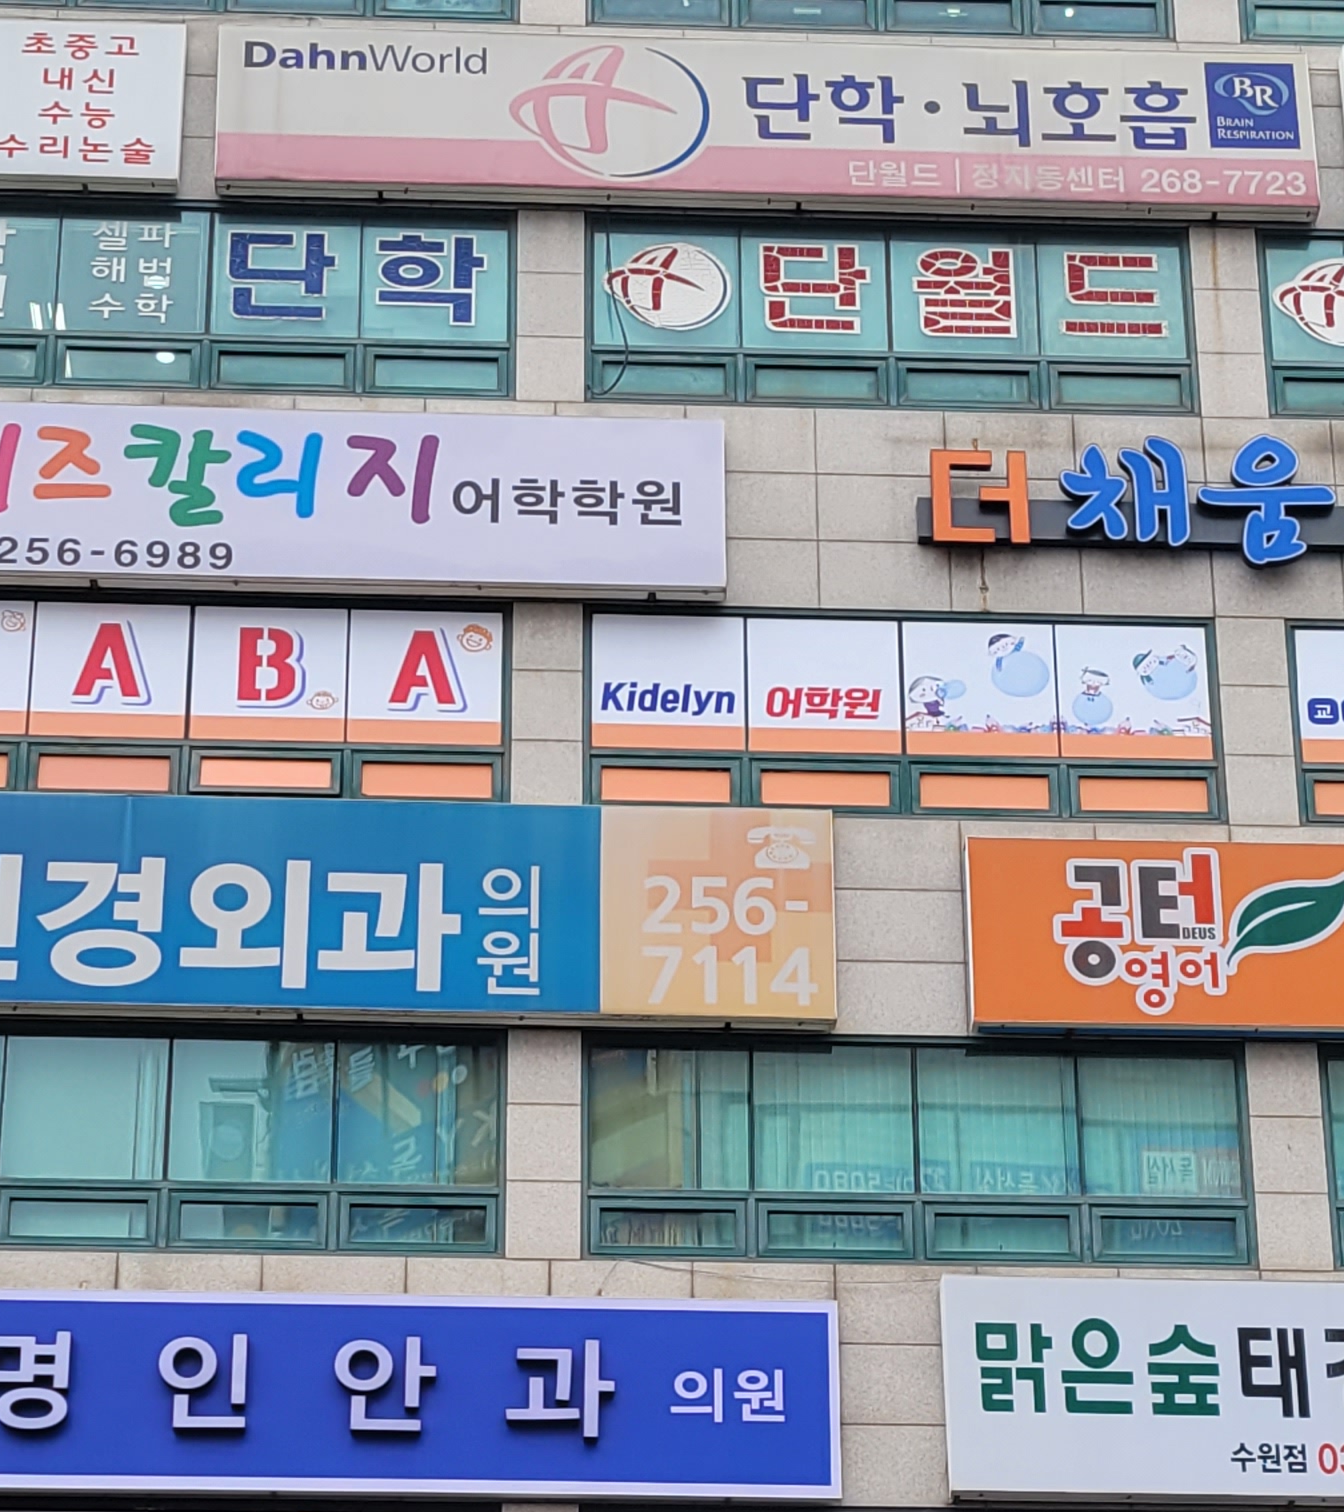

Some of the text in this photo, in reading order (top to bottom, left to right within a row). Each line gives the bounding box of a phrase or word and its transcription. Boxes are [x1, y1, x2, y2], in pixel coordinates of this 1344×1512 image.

[20, 30, 142, 60] 초중고
[242, 41, 490, 77] DahnWorld
[40, 66, 119, 97] 내신
[36, 99, 117, 130] 수능
[1216, 115, 1255, 128] BRAIN
[1216, 128, 1295, 141] RESPIRATION
[847, 160, 942, 188] 단월드
[1140, 168, 1308, 196] 268-7723
[91, 220, 178, 251] 셀파
[89, 256, 173, 290] 해법
[225, 227, 488, 328] 단학
[758, 241, 1169, 340] 단월드
[87, 292, 175, 325] 수학
[451, 477, 685, 528] 어학학원
[925, 446, 1033, 547] 더
[1056, 432, 1338, 568] 채움
[599, 681, 884, 722] Kidelyn 어학원
[476, 864, 544, 997] 의원
[1181, 925, 1217, 942] DEUS
[642, 945, 820, 1008] 7114
[1123, 949, 1222, 1010] 영어
[667, 1366, 790, 1426] 의원
[1229, 1440, 1310, 1476] 수원점
